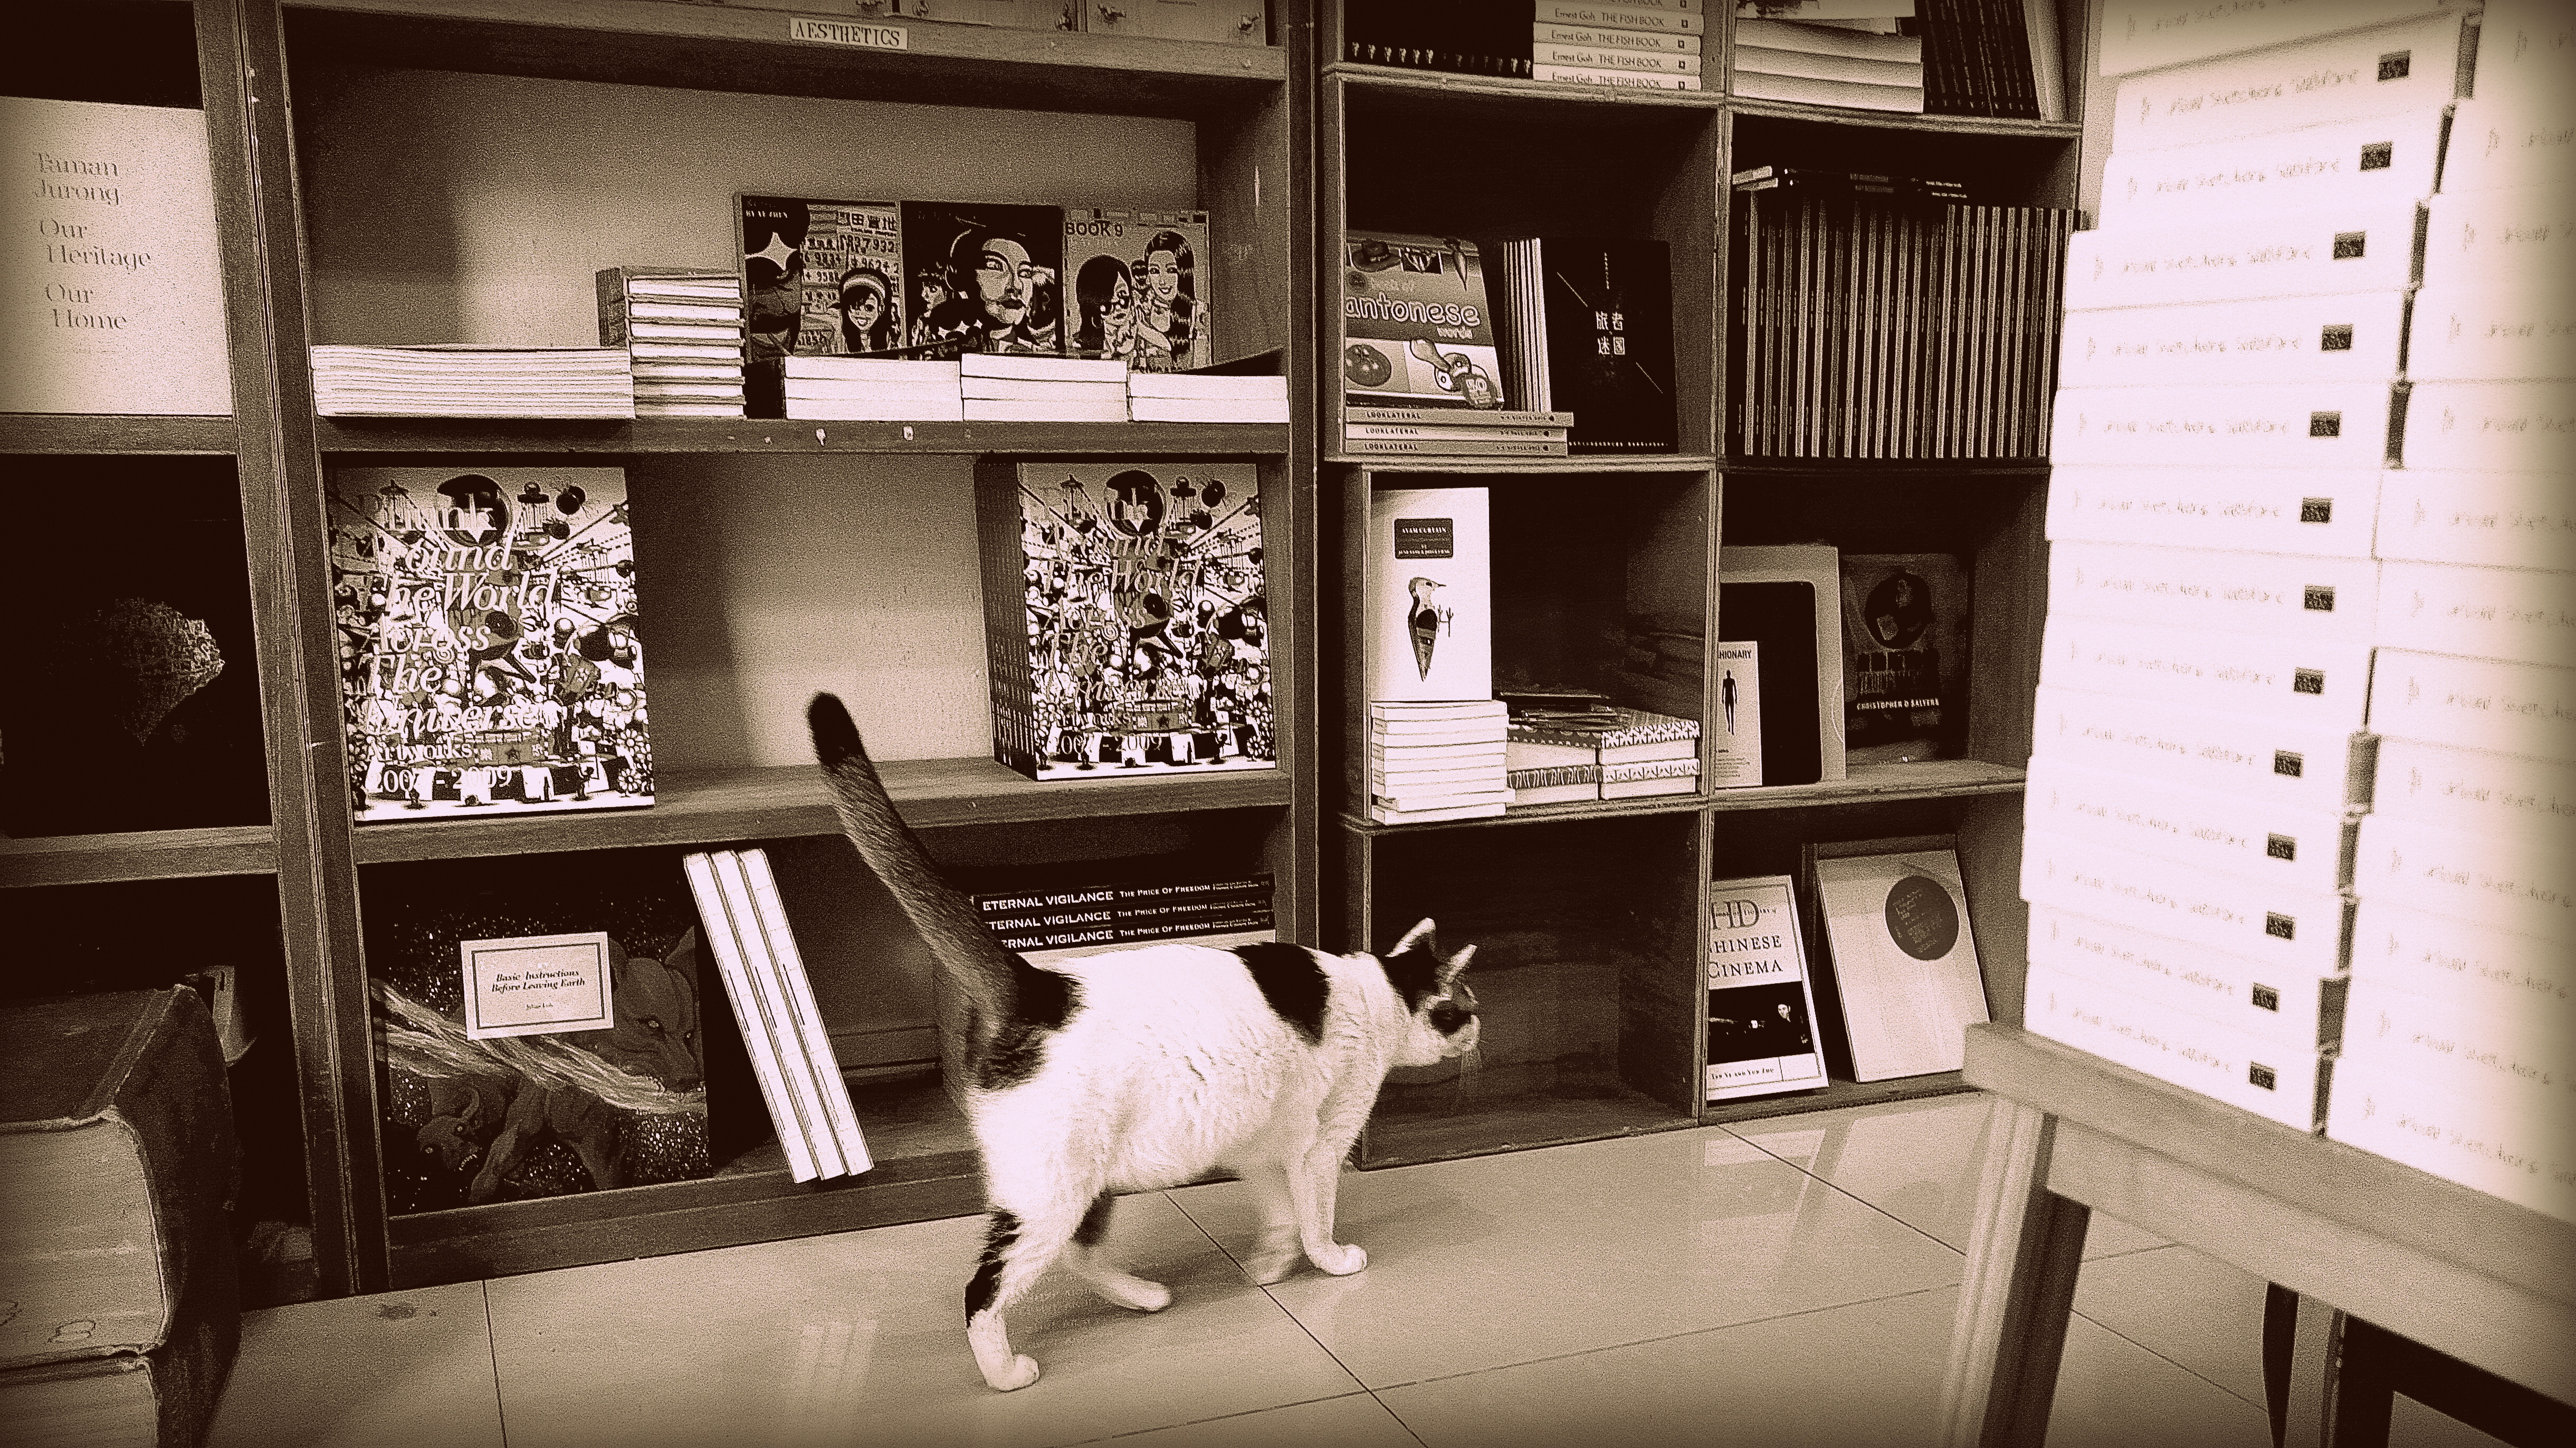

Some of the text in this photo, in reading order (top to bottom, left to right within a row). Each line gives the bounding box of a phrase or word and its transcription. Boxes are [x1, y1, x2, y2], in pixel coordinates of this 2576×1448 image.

[1601, 12, 1617, 23] THE
[1620, 13, 1637, 24] FISH
[1639, 15, 1664, 26] BOOK
[796, 21, 900, 47] AESTHETICS
[1598, 33, 1615, 44] THE
[1616, 35, 1634, 46] FISH
[1636, 36, 1661, 47] BOOK
[1599, 54, 1615, 64] THE
[1617, 55, 1635, 66] FISH
[1637, 57, 1662, 69] BOOK
[1599, 75, 1615, 85] THE
[1617, 77, 1635, 88] FISH
[1637, 78, 1662, 90] BOOK
[40, 218, 88, 238] Our
[1065, 220, 1123, 237] BOOK 9
[46, 244, 151, 271] Heritage
[45, 284, 93, 303] Our
[53, 308, 127, 330] Home
[1346, 291, 1481, 327] antonese
[443, 570, 557, 611] World
[982, 897, 1043, 911] ETERNAL
[1045, 891, 1114, 905] VIGILANCE
[1175, 885, 1210, 893] FREEDOM
[985, 917, 1041, 930] TERNAL
[1044, 911, 1111, 925] VIGILANCE
[1172, 904, 1207, 913] FREEDOM
[1001, 937, 1044, 948] ERNAL
[1045, 930, 1114, 944] VIGILANCE
[1175, 923, 1210, 932] FREEDOM
[1710, 935, 1782, 954] HINESE
[497, 969, 580, 982] Basic Instructions
[1708, 959, 1783, 979] CINEMA
[492, 977, 586, 994] Before Leaving Earth
